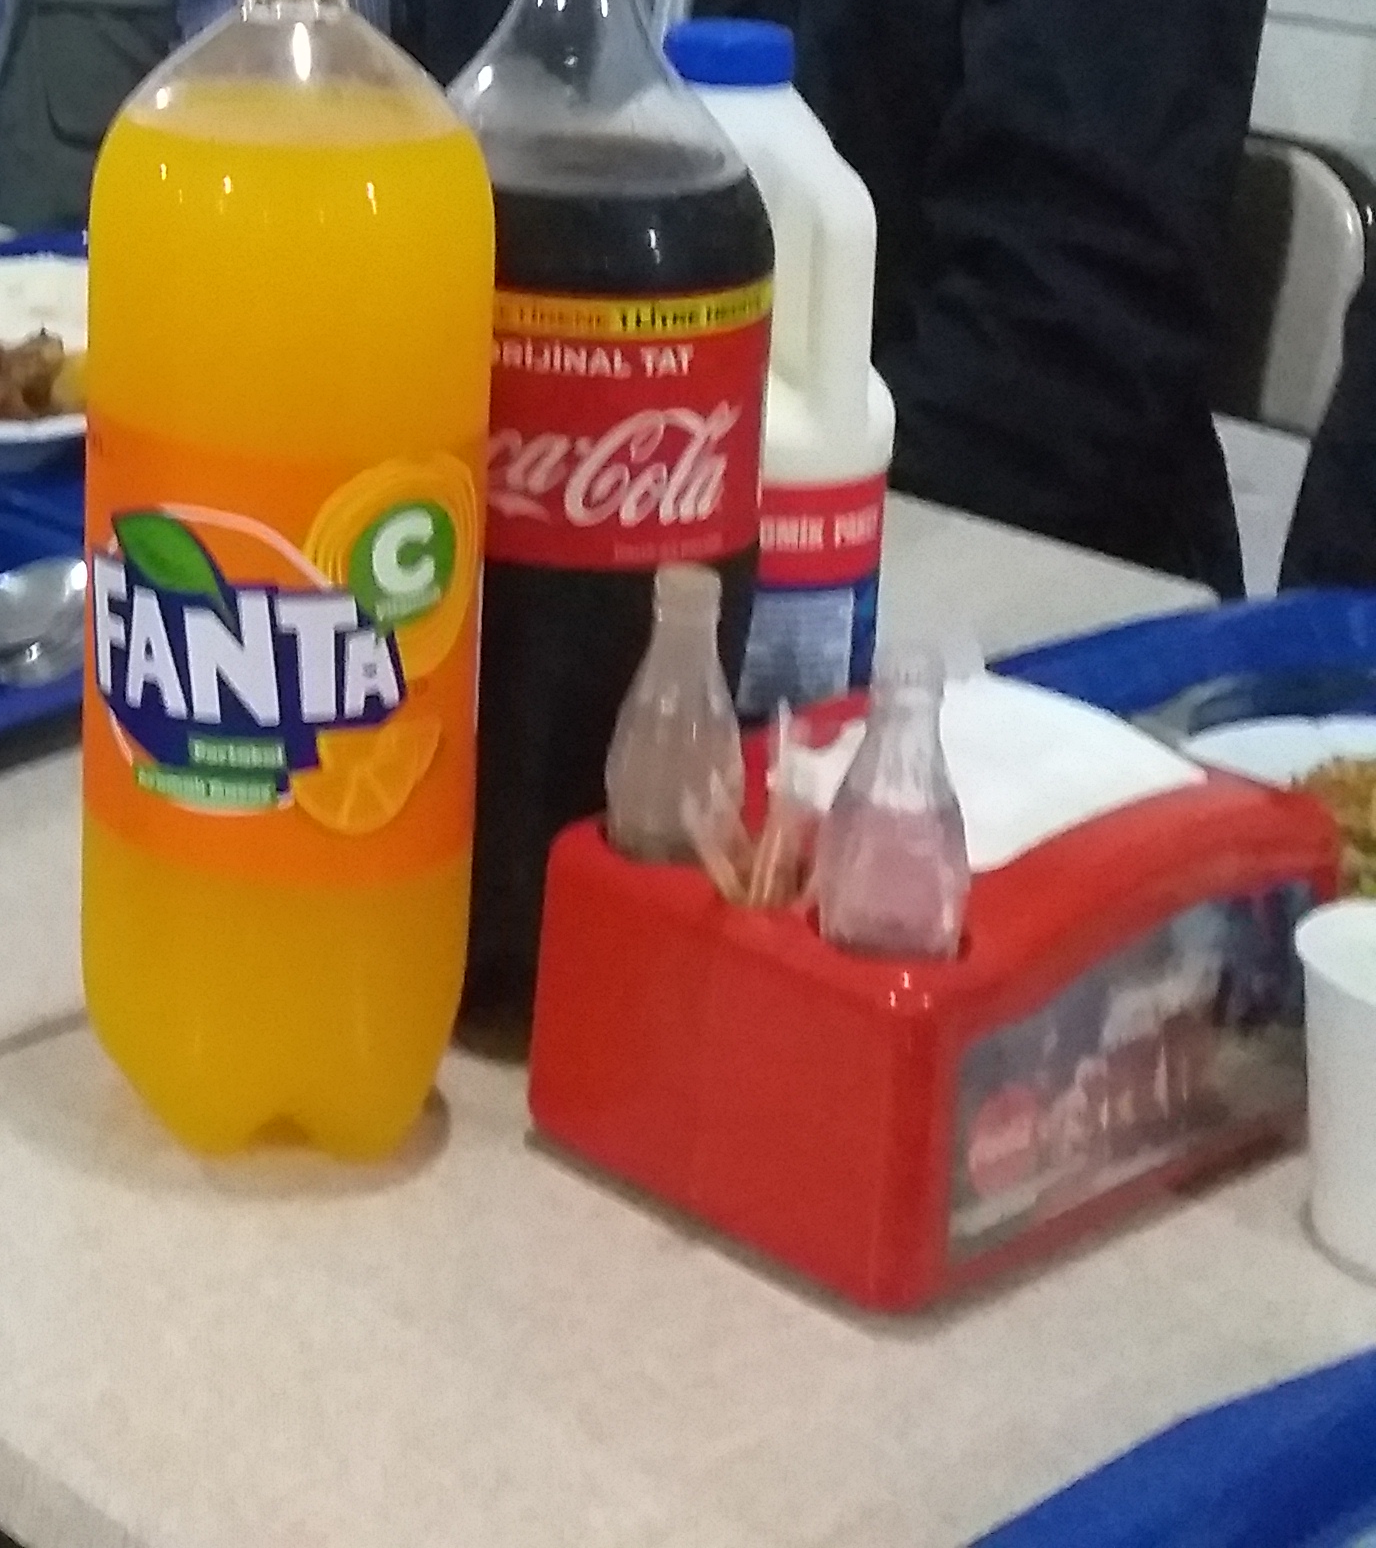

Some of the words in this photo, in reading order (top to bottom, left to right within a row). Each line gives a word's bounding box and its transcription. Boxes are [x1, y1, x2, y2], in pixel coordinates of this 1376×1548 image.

[495, 338, 632, 379] RİJİNAL
[641, 343, 694, 379] TAT
[372, 509, 435, 593] C
[94, 554, 400, 727] FANTA
